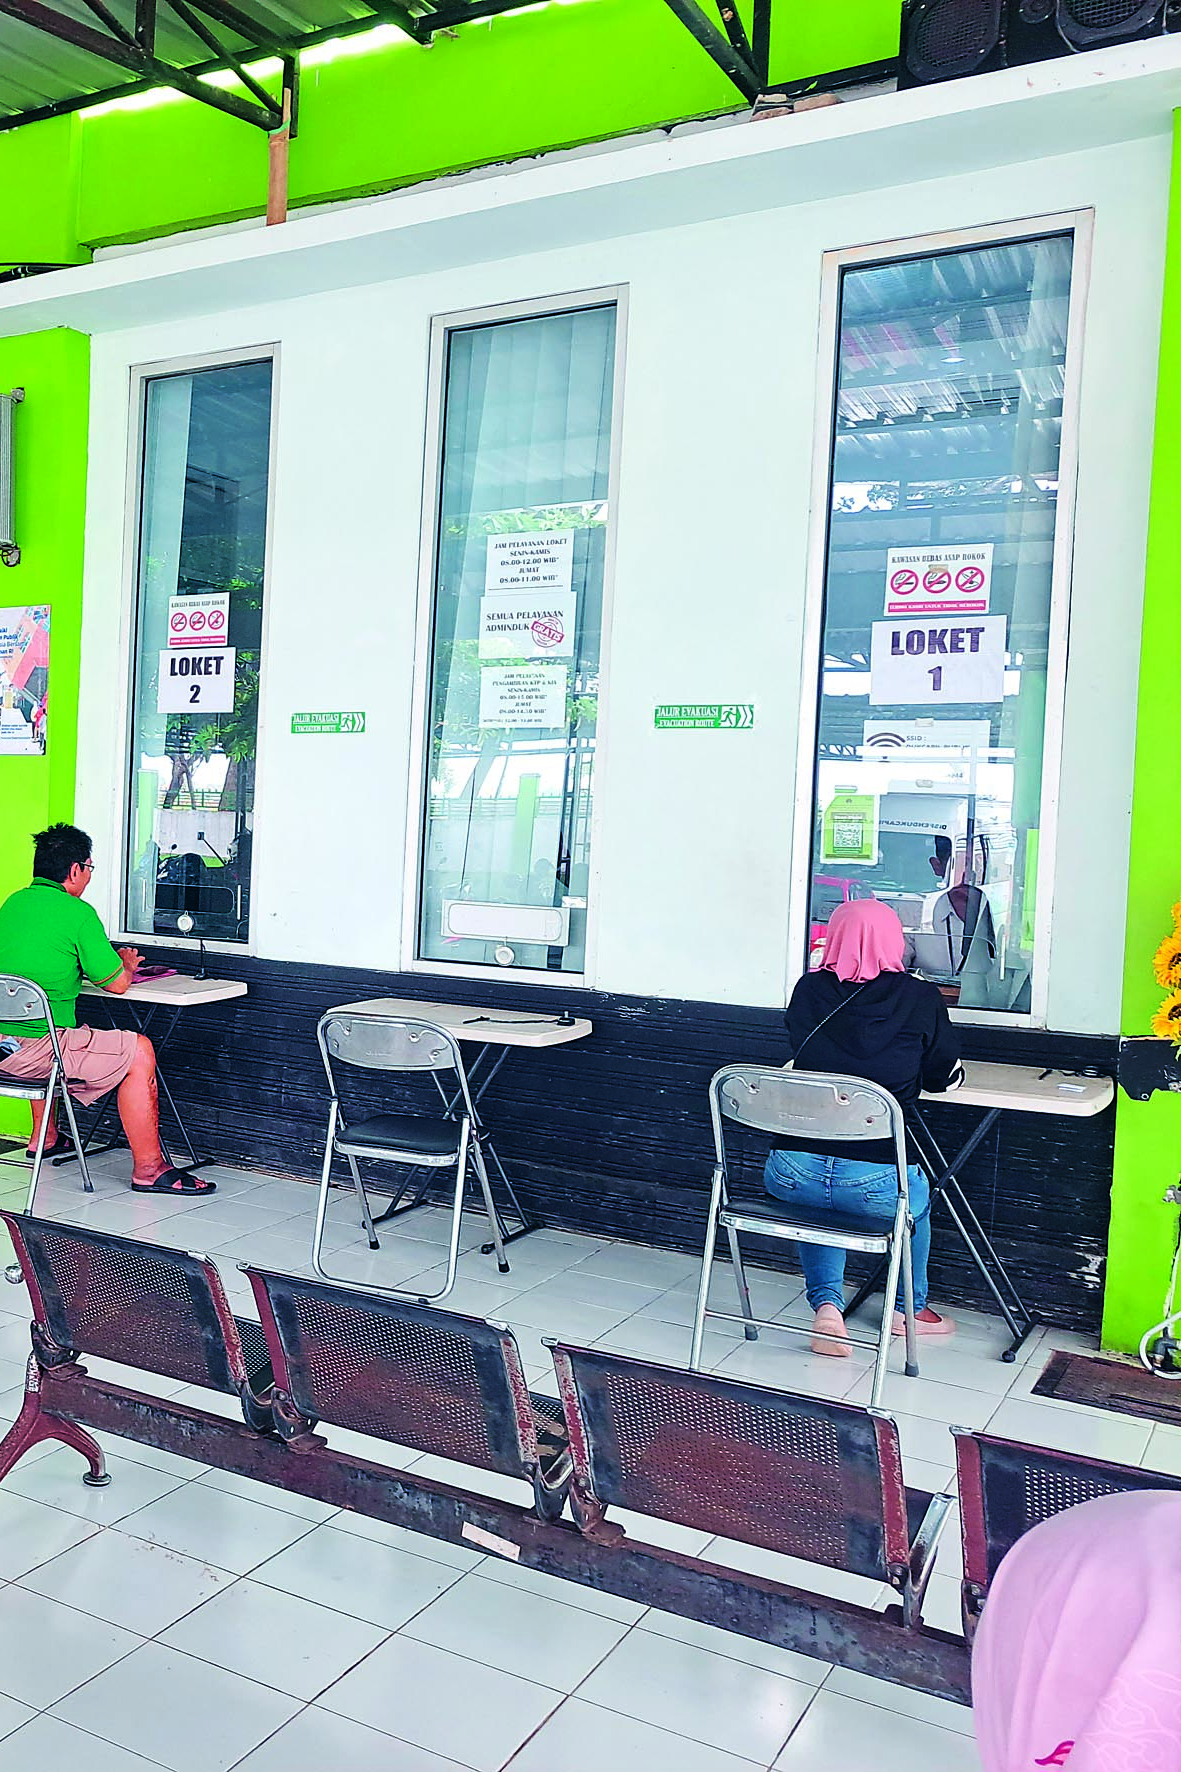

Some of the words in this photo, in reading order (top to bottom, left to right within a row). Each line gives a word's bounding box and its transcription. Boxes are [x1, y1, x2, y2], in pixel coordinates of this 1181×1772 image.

[509, 540, 544, 548] PELAYANAN
[546, 538, 567, 546] LOKET
[510, 549, 551, 557] SENIN-KAMIS
[486, 612, 514, 620] SEMUA
[516, 610, 564, 619] PELAYANAN
[485, 624, 530, 632] ADMINDUK
[534, 624, 562, 642] GRATIS
[890, 626, 986, 656] LOKET
[170, 655, 225, 676] LOKET
[927, 665, 943, 691] 1
[189, 684, 201, 704] 2
[681, 706, 719, 717] EVAKUASI
